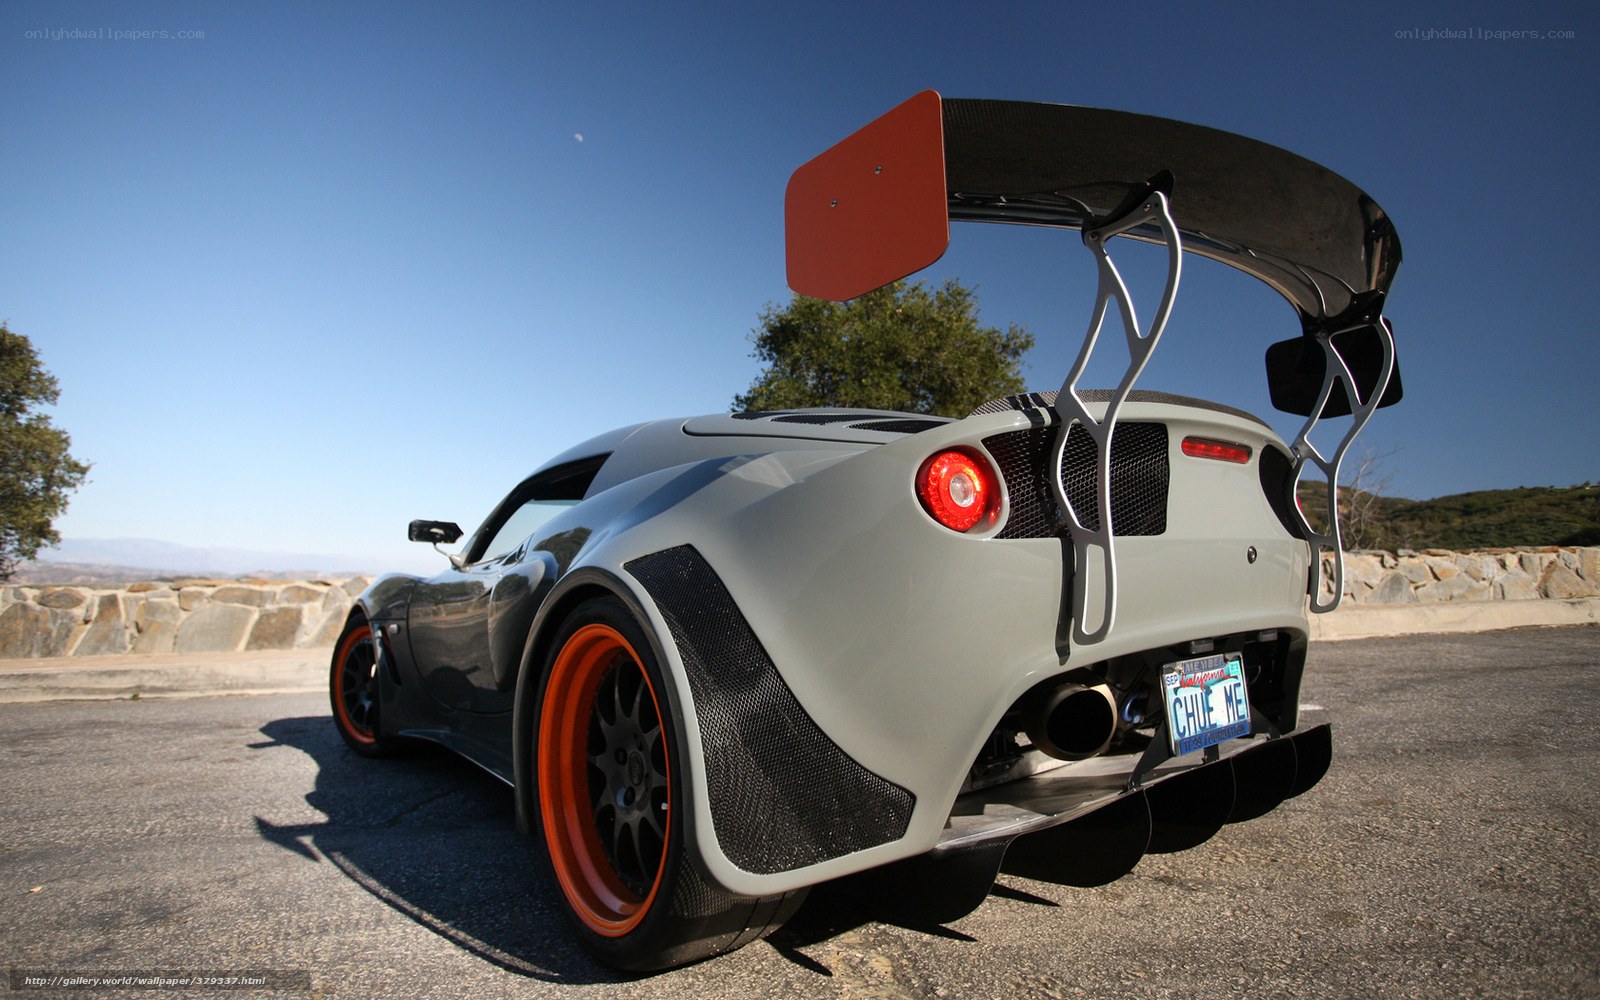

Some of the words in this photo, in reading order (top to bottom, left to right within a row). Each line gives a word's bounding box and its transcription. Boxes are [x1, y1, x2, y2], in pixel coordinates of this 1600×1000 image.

[1165, 674, 1179, 687] SEP
[1173, 688, 1217, 738] CHUE
[1224, 682, 1245, 725] ME
